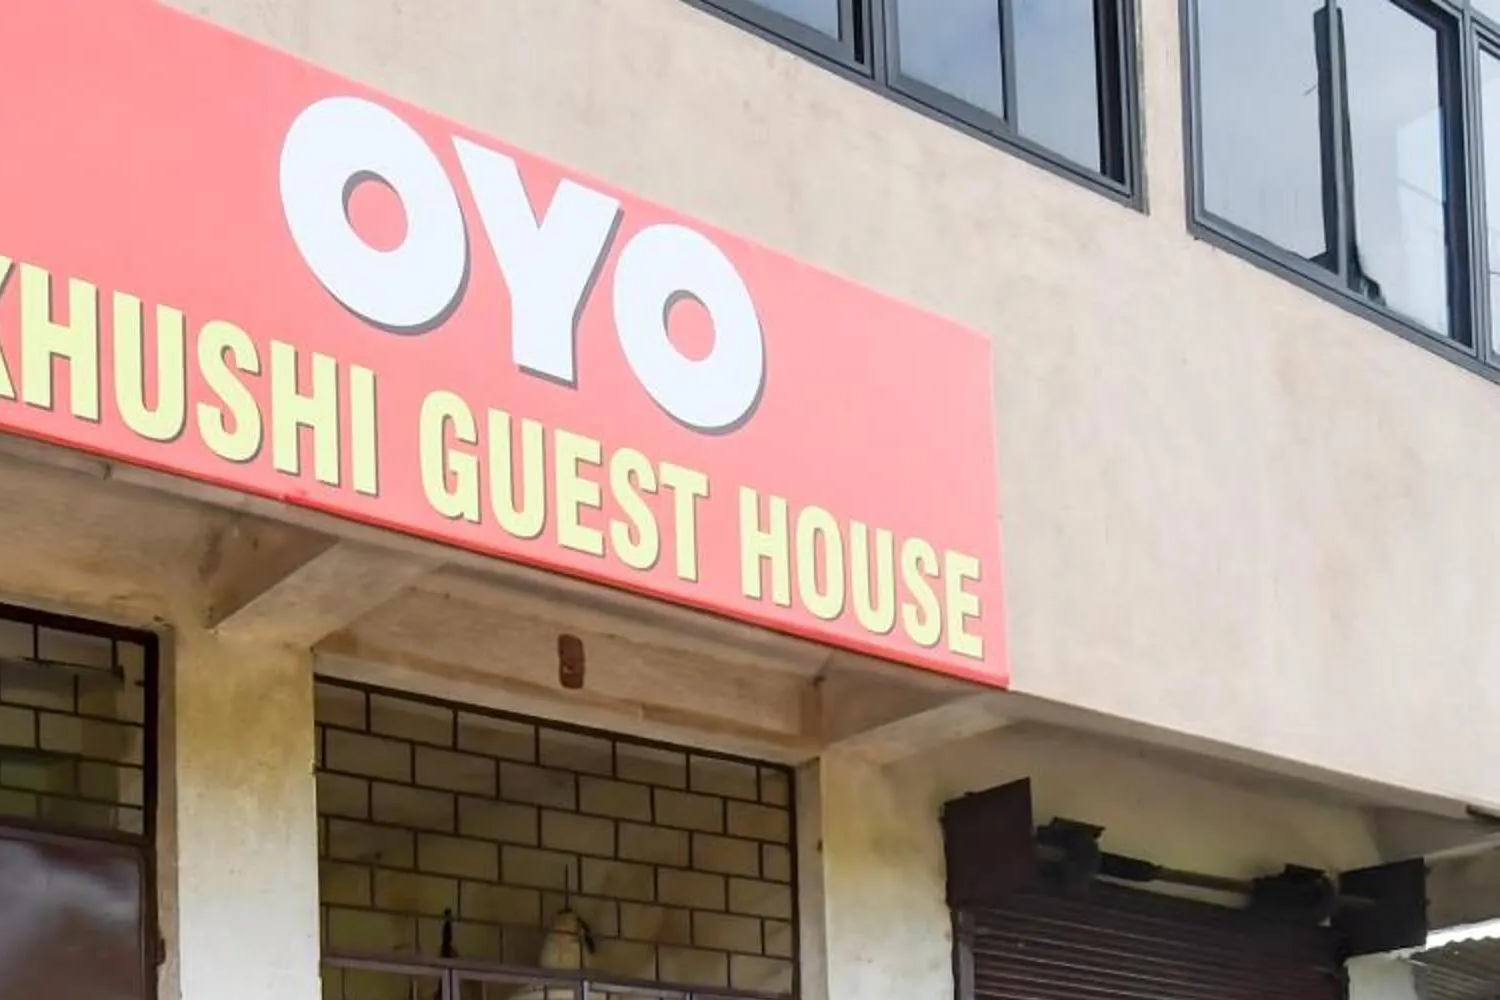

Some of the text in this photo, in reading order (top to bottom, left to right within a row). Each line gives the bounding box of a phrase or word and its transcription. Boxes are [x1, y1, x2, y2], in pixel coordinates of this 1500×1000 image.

[280, 96, 766, 435] OYO
[418, 390, 710, 582] GUEST
[739, 487, 986, 660] HOUSE
